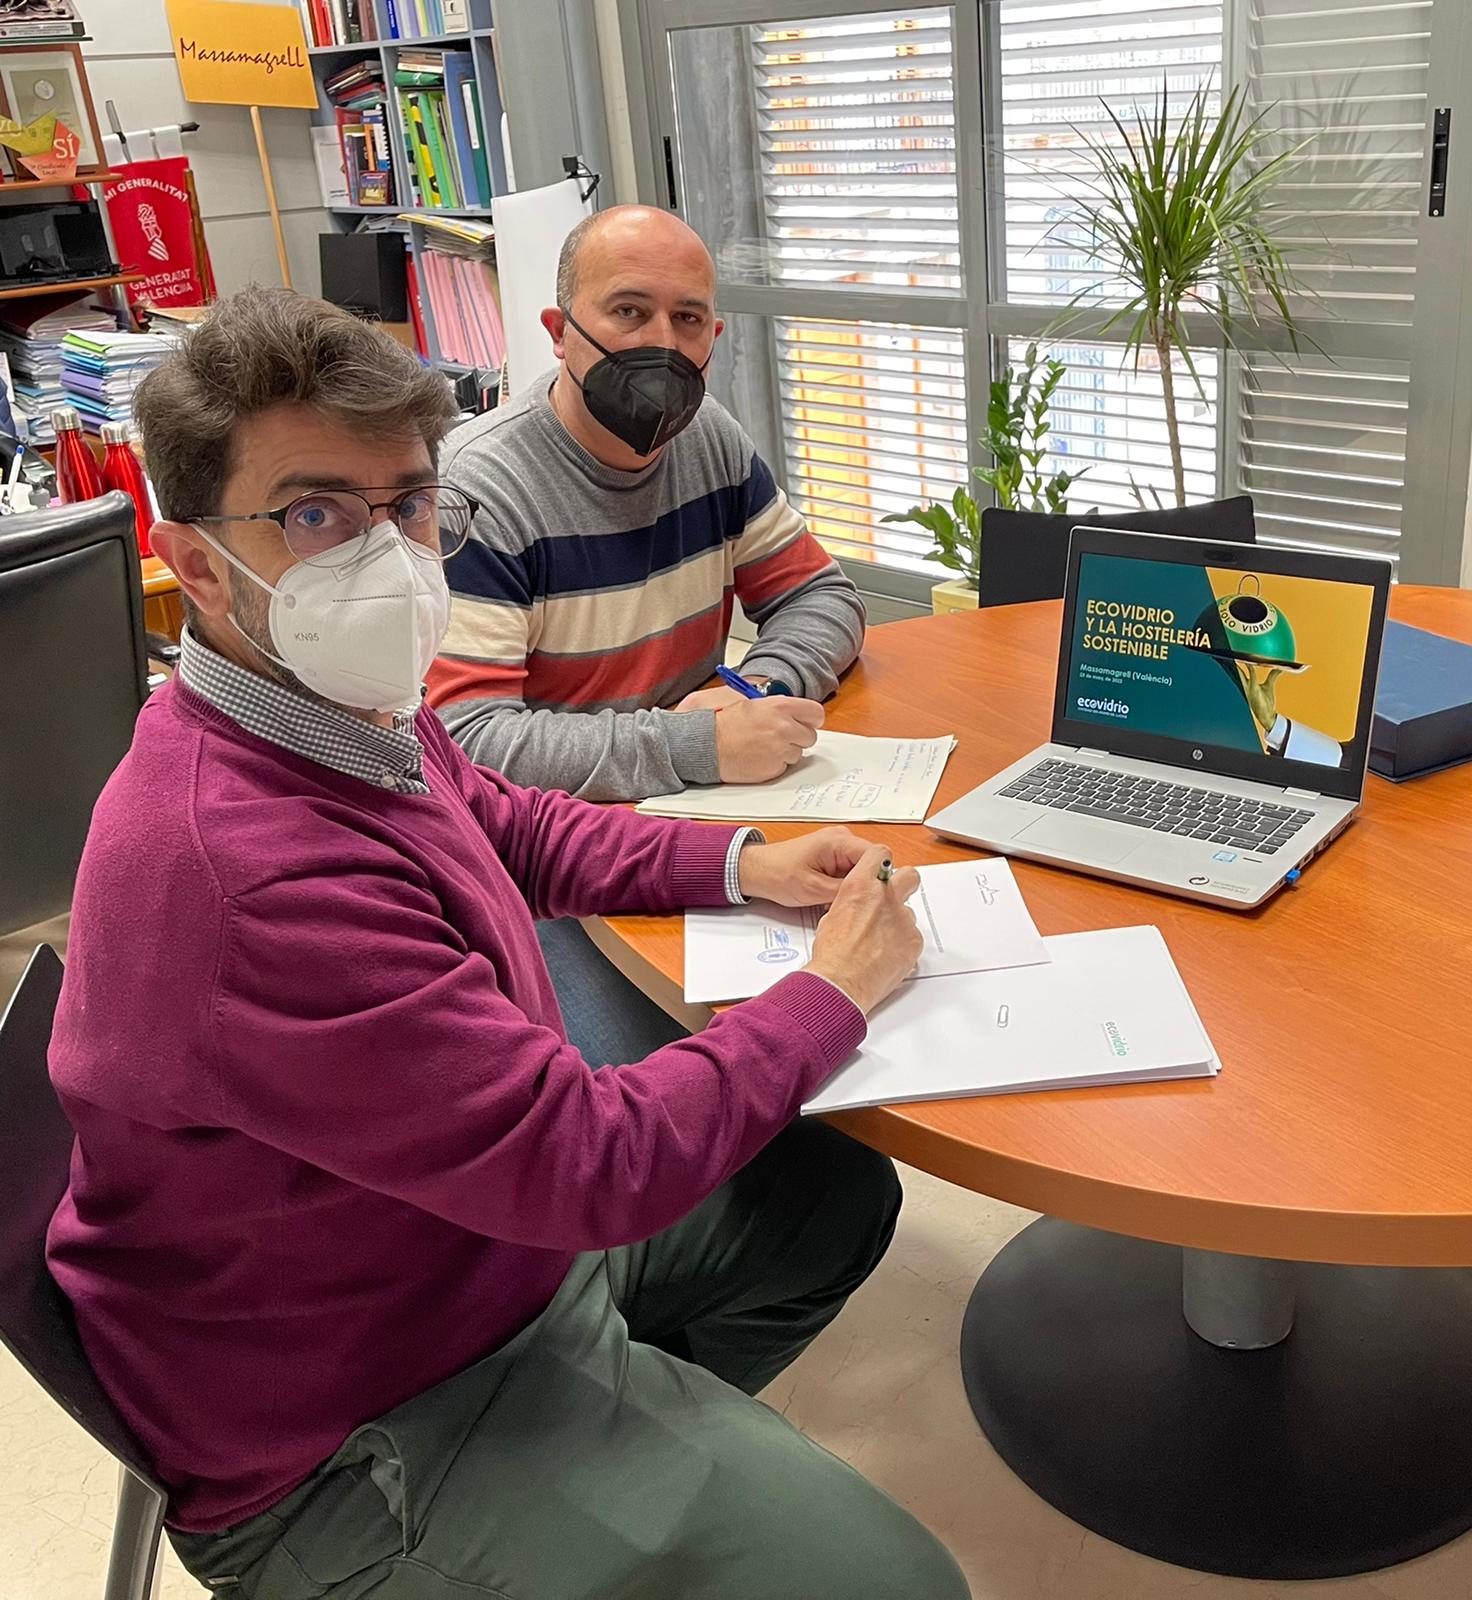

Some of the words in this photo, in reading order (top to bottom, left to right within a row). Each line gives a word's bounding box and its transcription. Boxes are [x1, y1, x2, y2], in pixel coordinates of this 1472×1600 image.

[180, 37, 305, 74] Massamagrell
[53, 133, 76, 158] SÍ
[1086, 599, 1174, 624] ECOVIDRIO
[1219, 607, 1237, 629] SOLO
[1241, 618, 1274, 634] VIDRIO
[294, 632, 320, 642] KN95
[1086, 616, 1096, 632] Y
[1098, 619, 1118, 635] LA
[1121, 622, 1212, 649] HOSTELERÍA
[1082, 634, 1169, 660] SOSTENIBLE
[1079, 663, 1131, 678] Massamagrell
[1132, 671, 1173, 686] (València)
[1077, 697, 1129, 714] ecovidrio
[1105, 1021, 1130, 1056] ecovidrio
